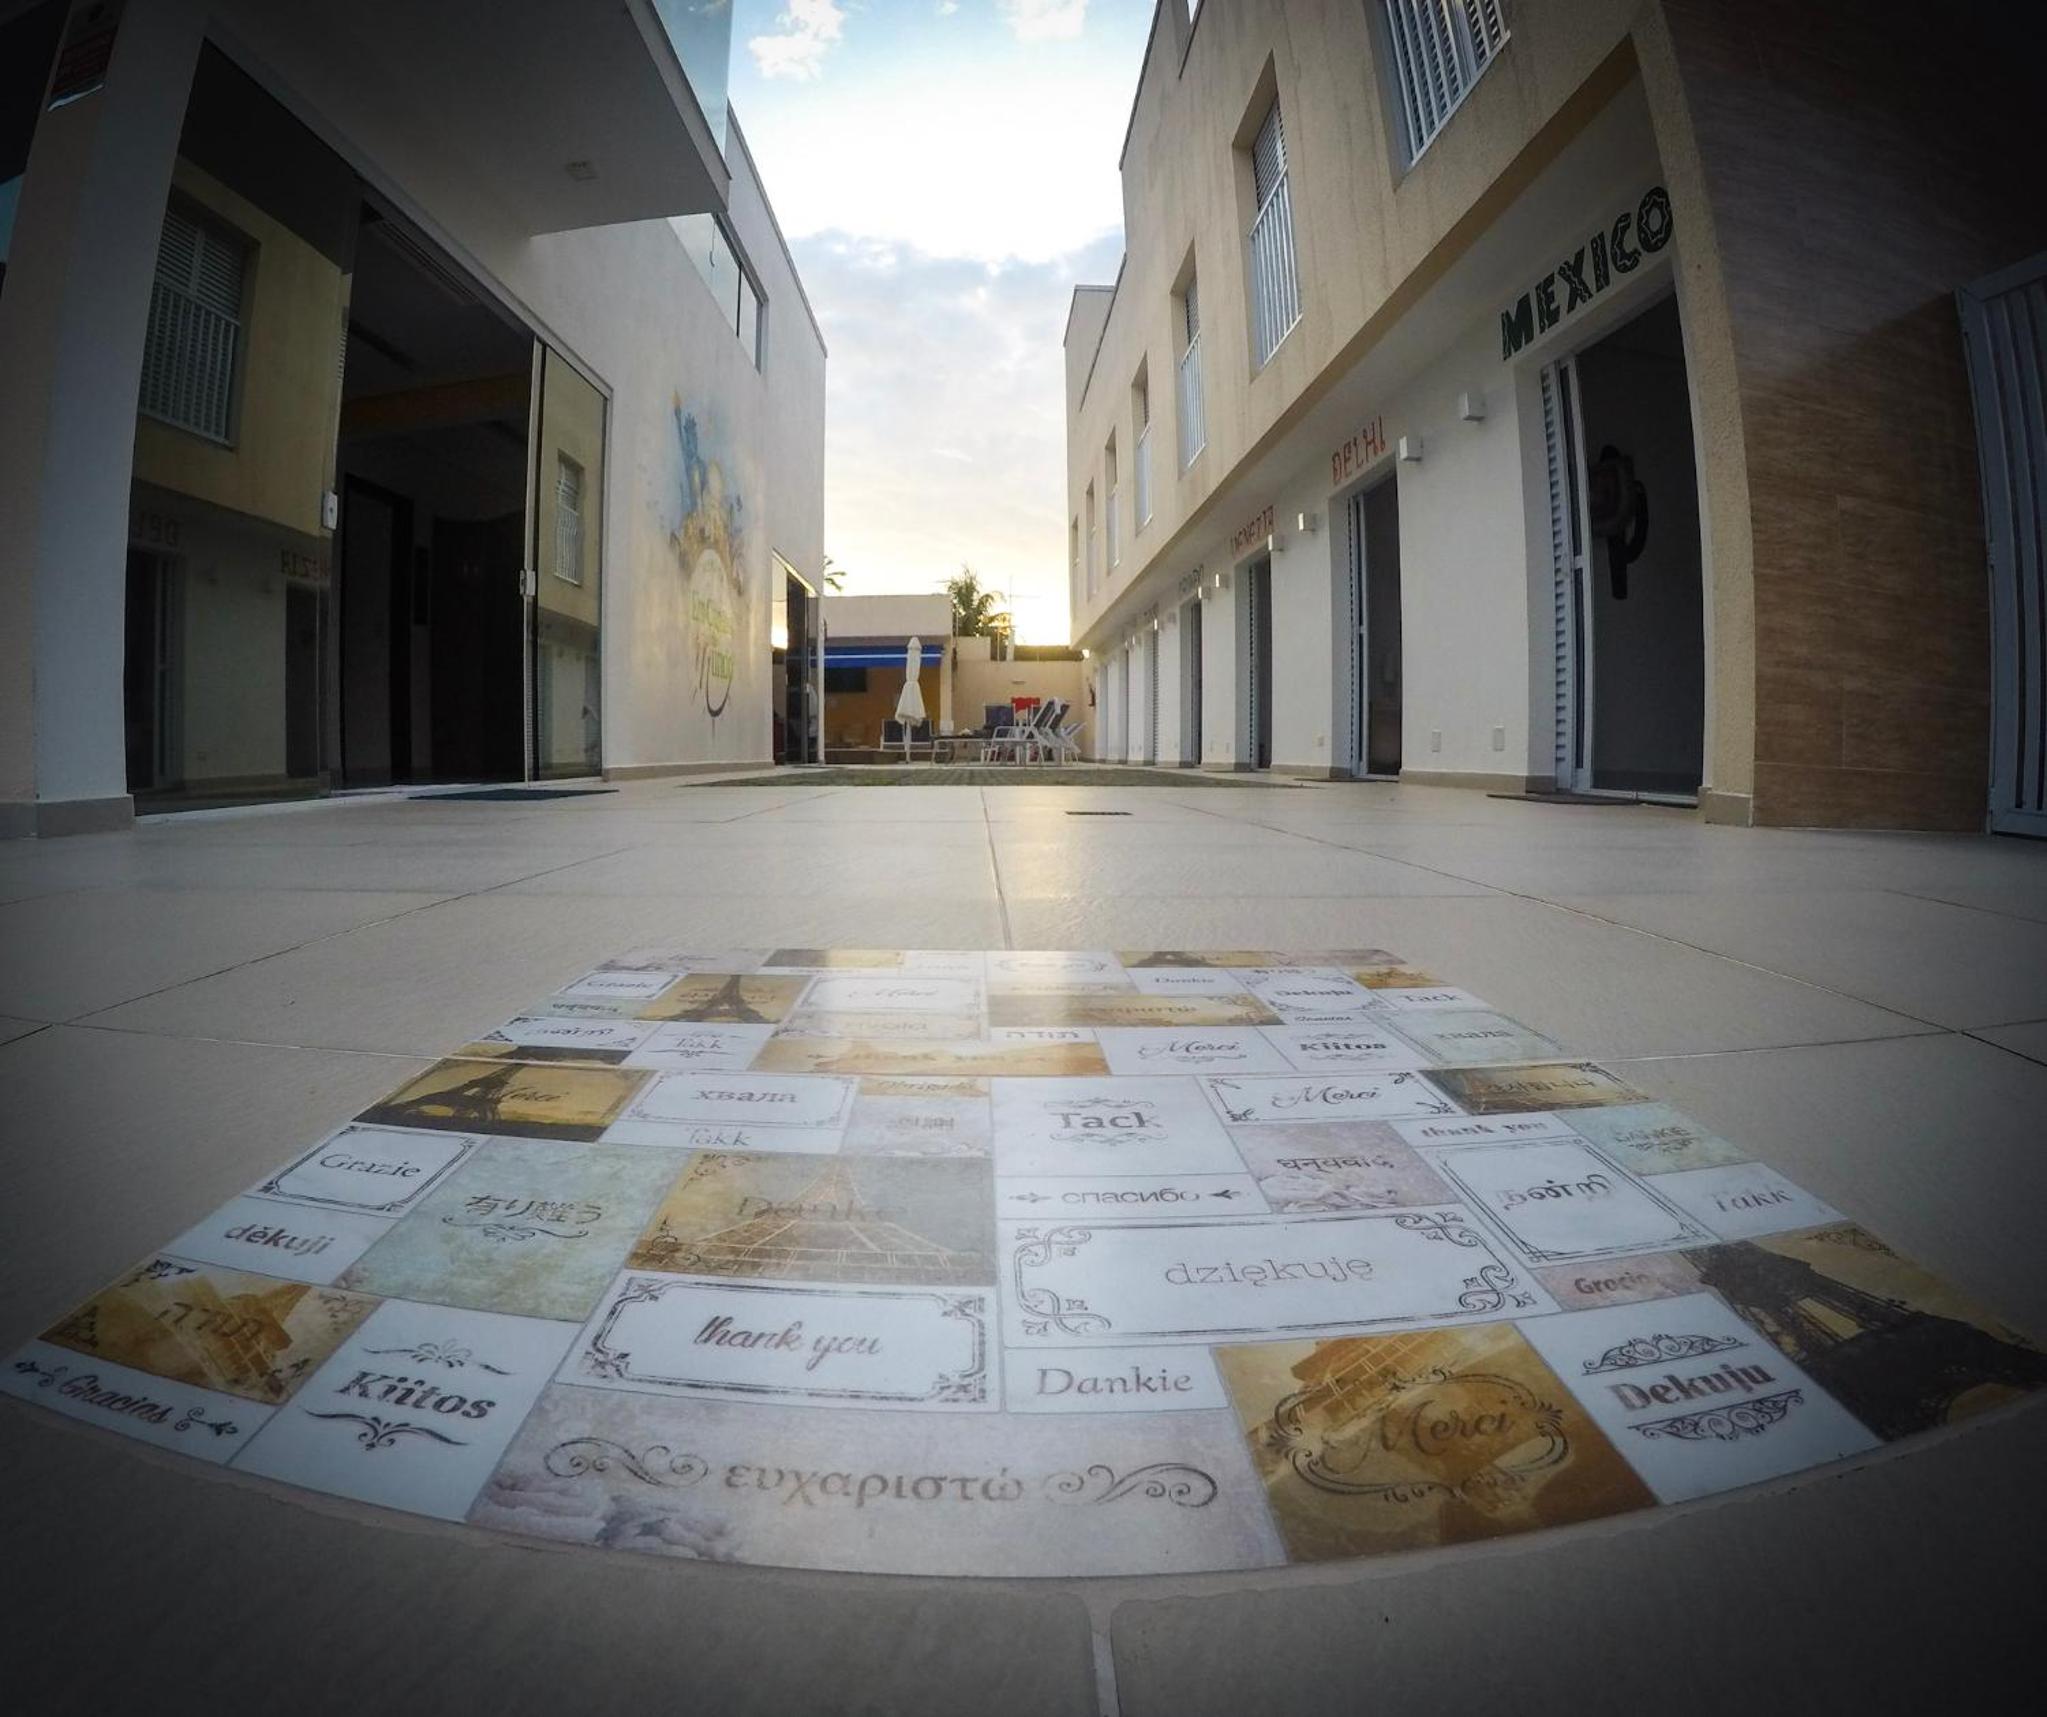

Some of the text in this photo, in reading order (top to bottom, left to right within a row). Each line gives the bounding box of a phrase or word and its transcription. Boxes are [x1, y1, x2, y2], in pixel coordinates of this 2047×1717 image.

[1501, 186, 1674, 361] MEXICO
[1331, 415, 1386, 485] DELHI
[1299, 1042, 1387, 1051] Kiitos
[692, 1088, 798, 1106] хвала
[1271, 1086, 1381, 1109] Merci
[1048, 1111, 1163, 1130] Tack
[1421, 1124, 1495, 1138] thank
[319, 1153, 422, 1178] Grazie
[1061, 1187, 1200, 1205] спасибо
[223, 1223, 336, 1257] děkuji
[1163, 1256, 1375, 1288] dziękuję
[692, 1315, 881, 1370] thank you
[338, 1369, 497, 1421] Kiitos
[1036, 1366, 1195, 1396] Dankie
[1604, 1363, 1776, 1411] Dekuju
[1322, 1397, 1515, 1475] Merci
[723, 1459, 1023, 1508] ευχαριστώ
